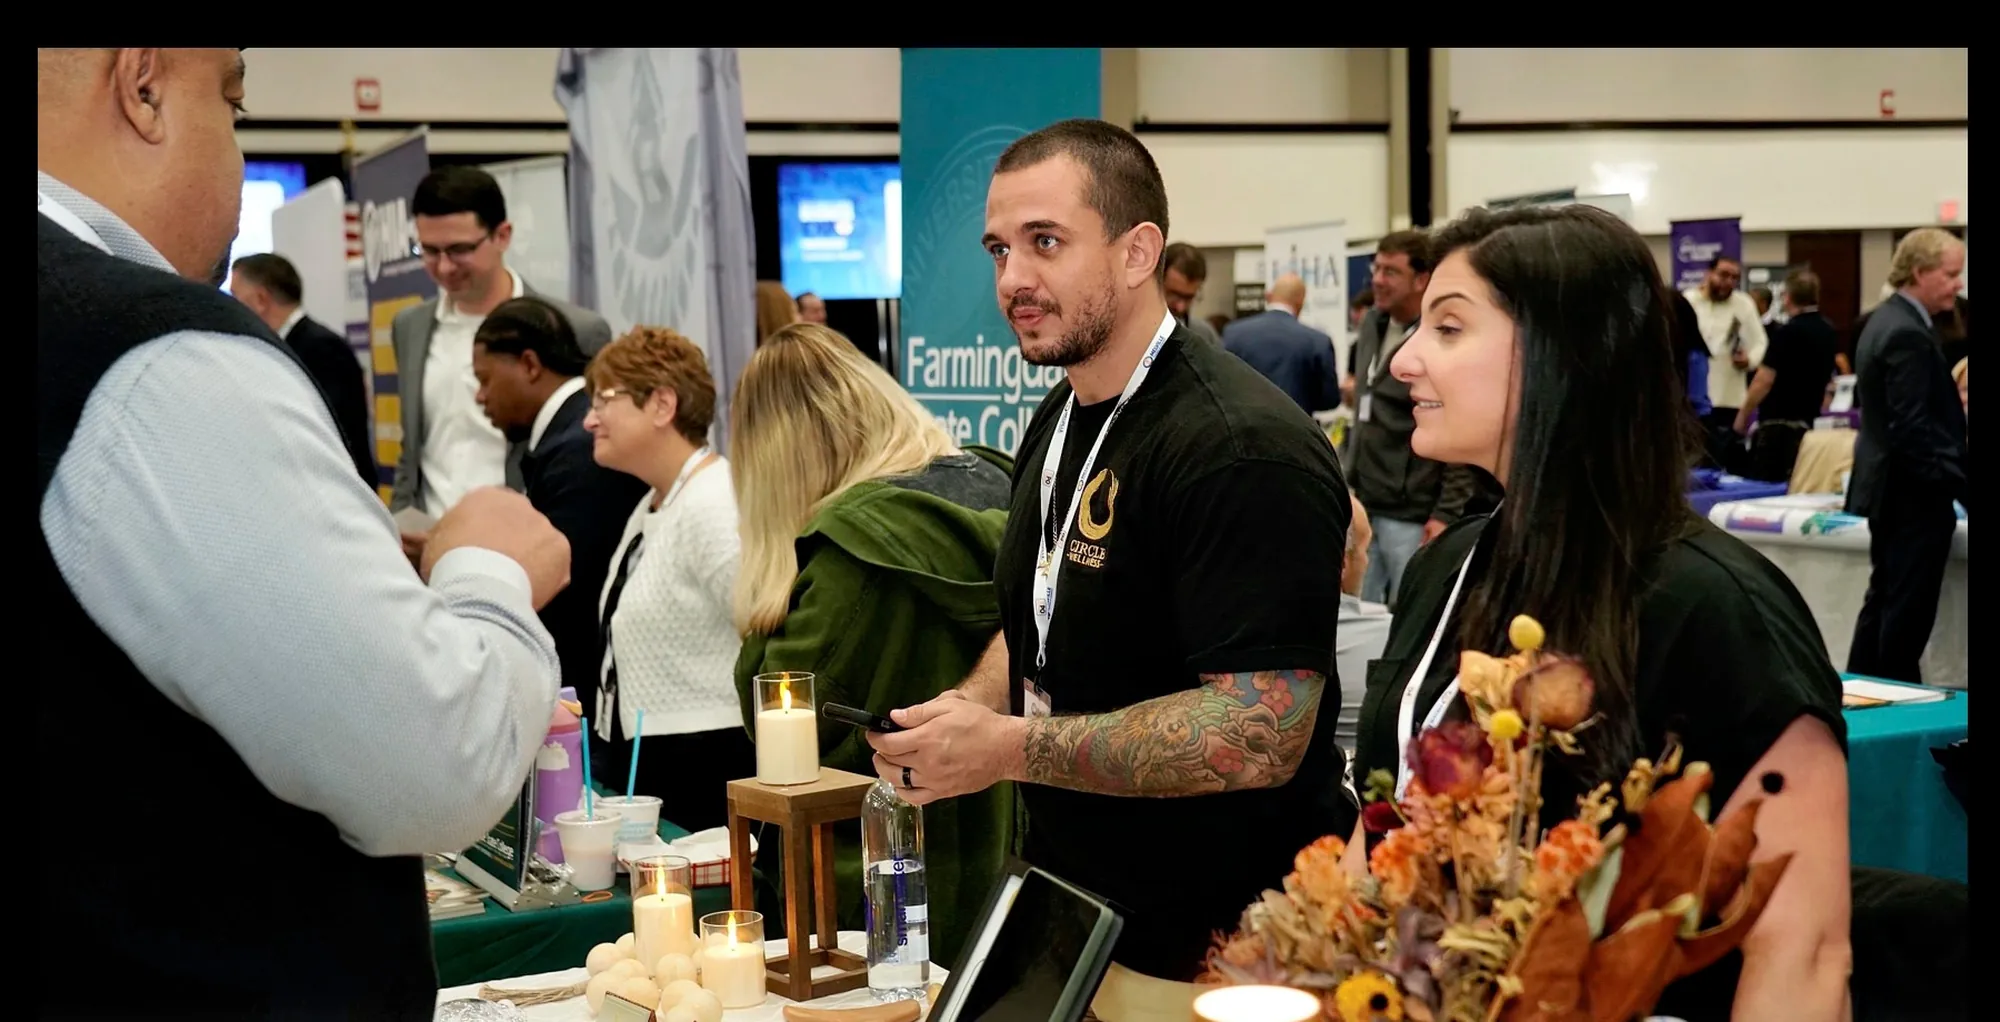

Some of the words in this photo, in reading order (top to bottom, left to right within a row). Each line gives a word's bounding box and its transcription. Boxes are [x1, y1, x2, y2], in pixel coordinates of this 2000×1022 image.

[907, 334, 1068, 404] Farmingda
[978, 405, 1034, 456] Coll
[1070, 539, 1106, 560] CIRCLE
